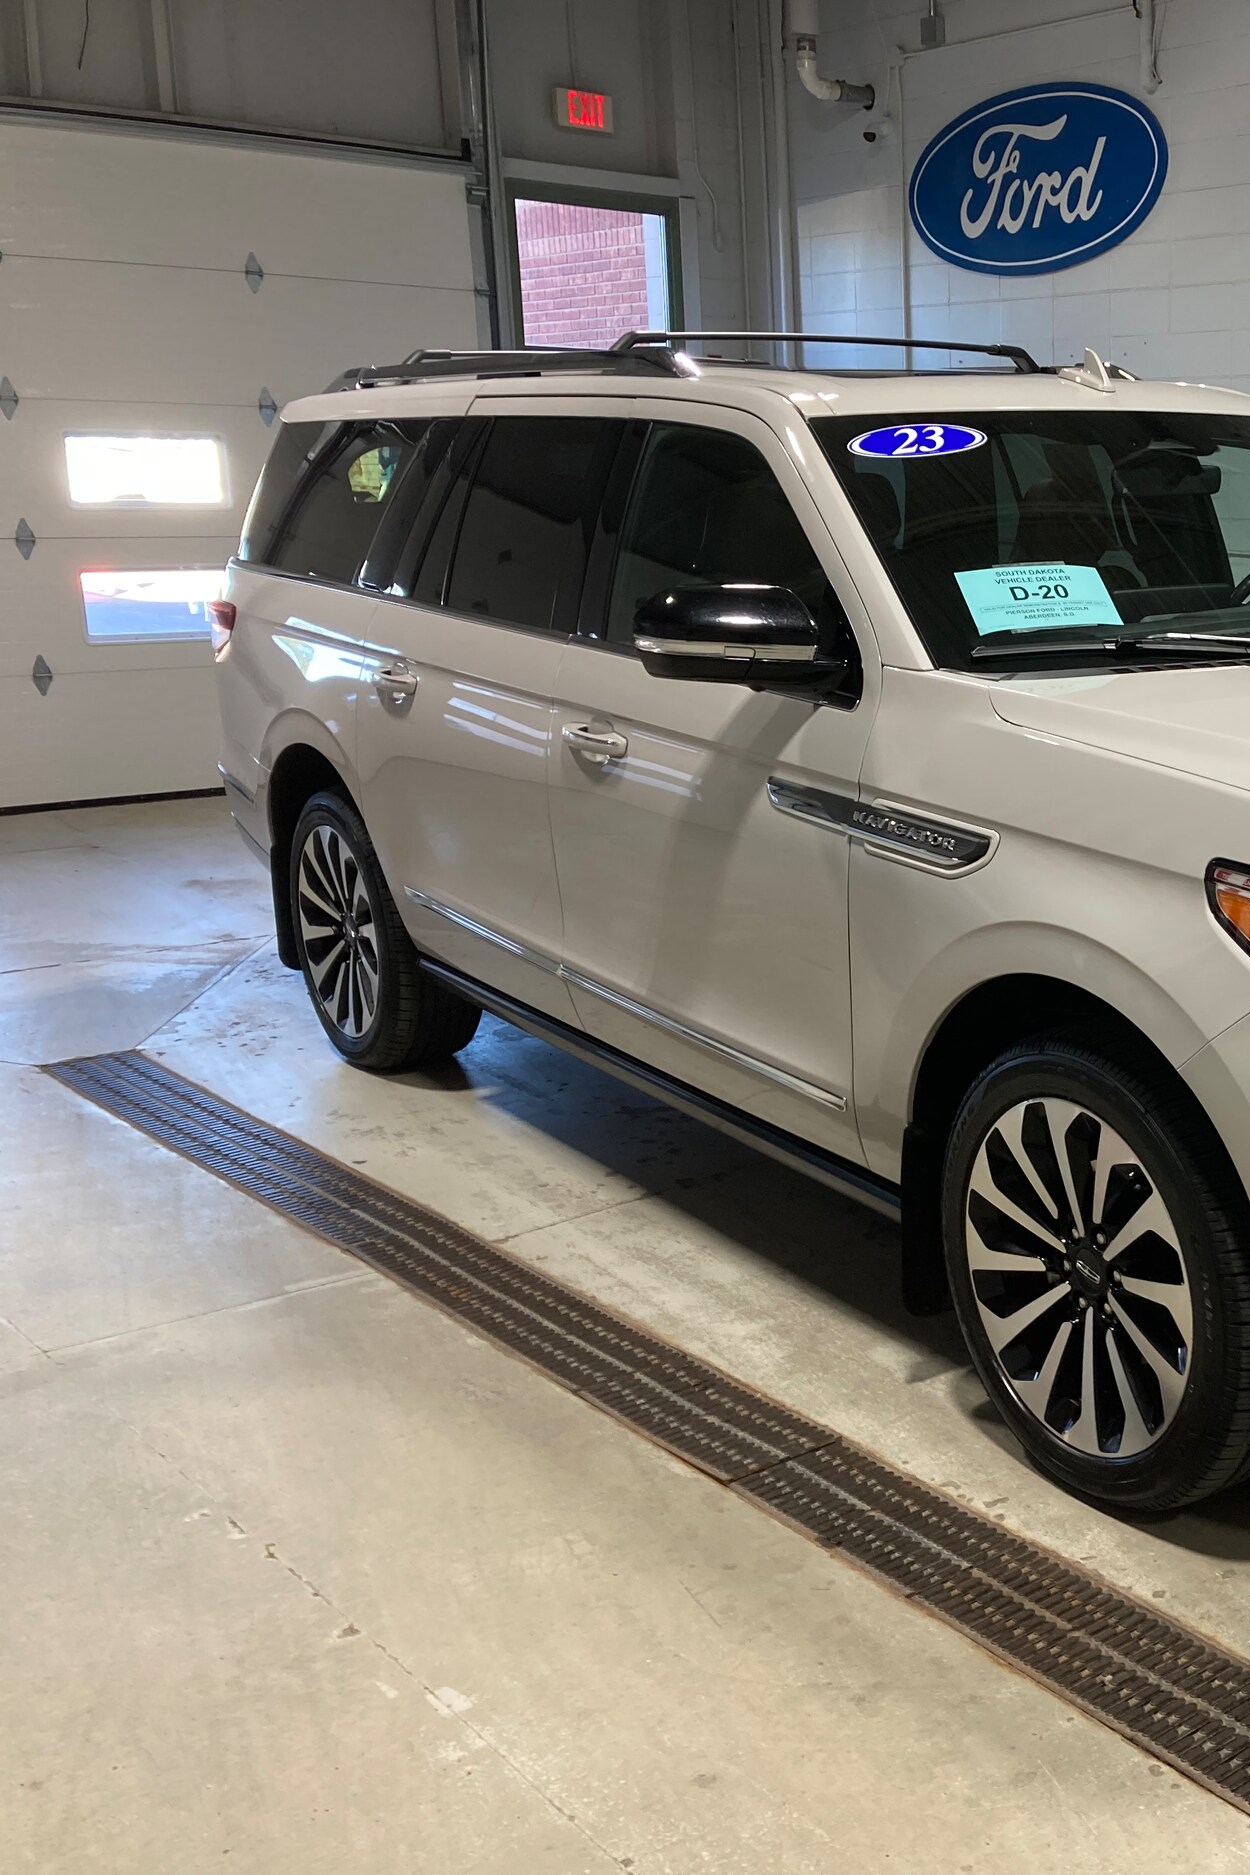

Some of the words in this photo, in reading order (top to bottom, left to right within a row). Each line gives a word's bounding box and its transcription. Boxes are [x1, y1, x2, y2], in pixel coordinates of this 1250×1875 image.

[567, 90, 604, 128] EXIT
[960, 113, 1107, 239] Ford
[891, 426, 945, 455] 23
[994, 577, 1034, 585] VEHICLE
[1035, 575, 1072, 583] DEALER
[995, 569, 1027, 578] SOUTH
[1028, 568, 1066, 576] DAKOTA
[1009, 584, 1069, 601] D-20
[853, 811, 956, 851] NAVIGATOR
